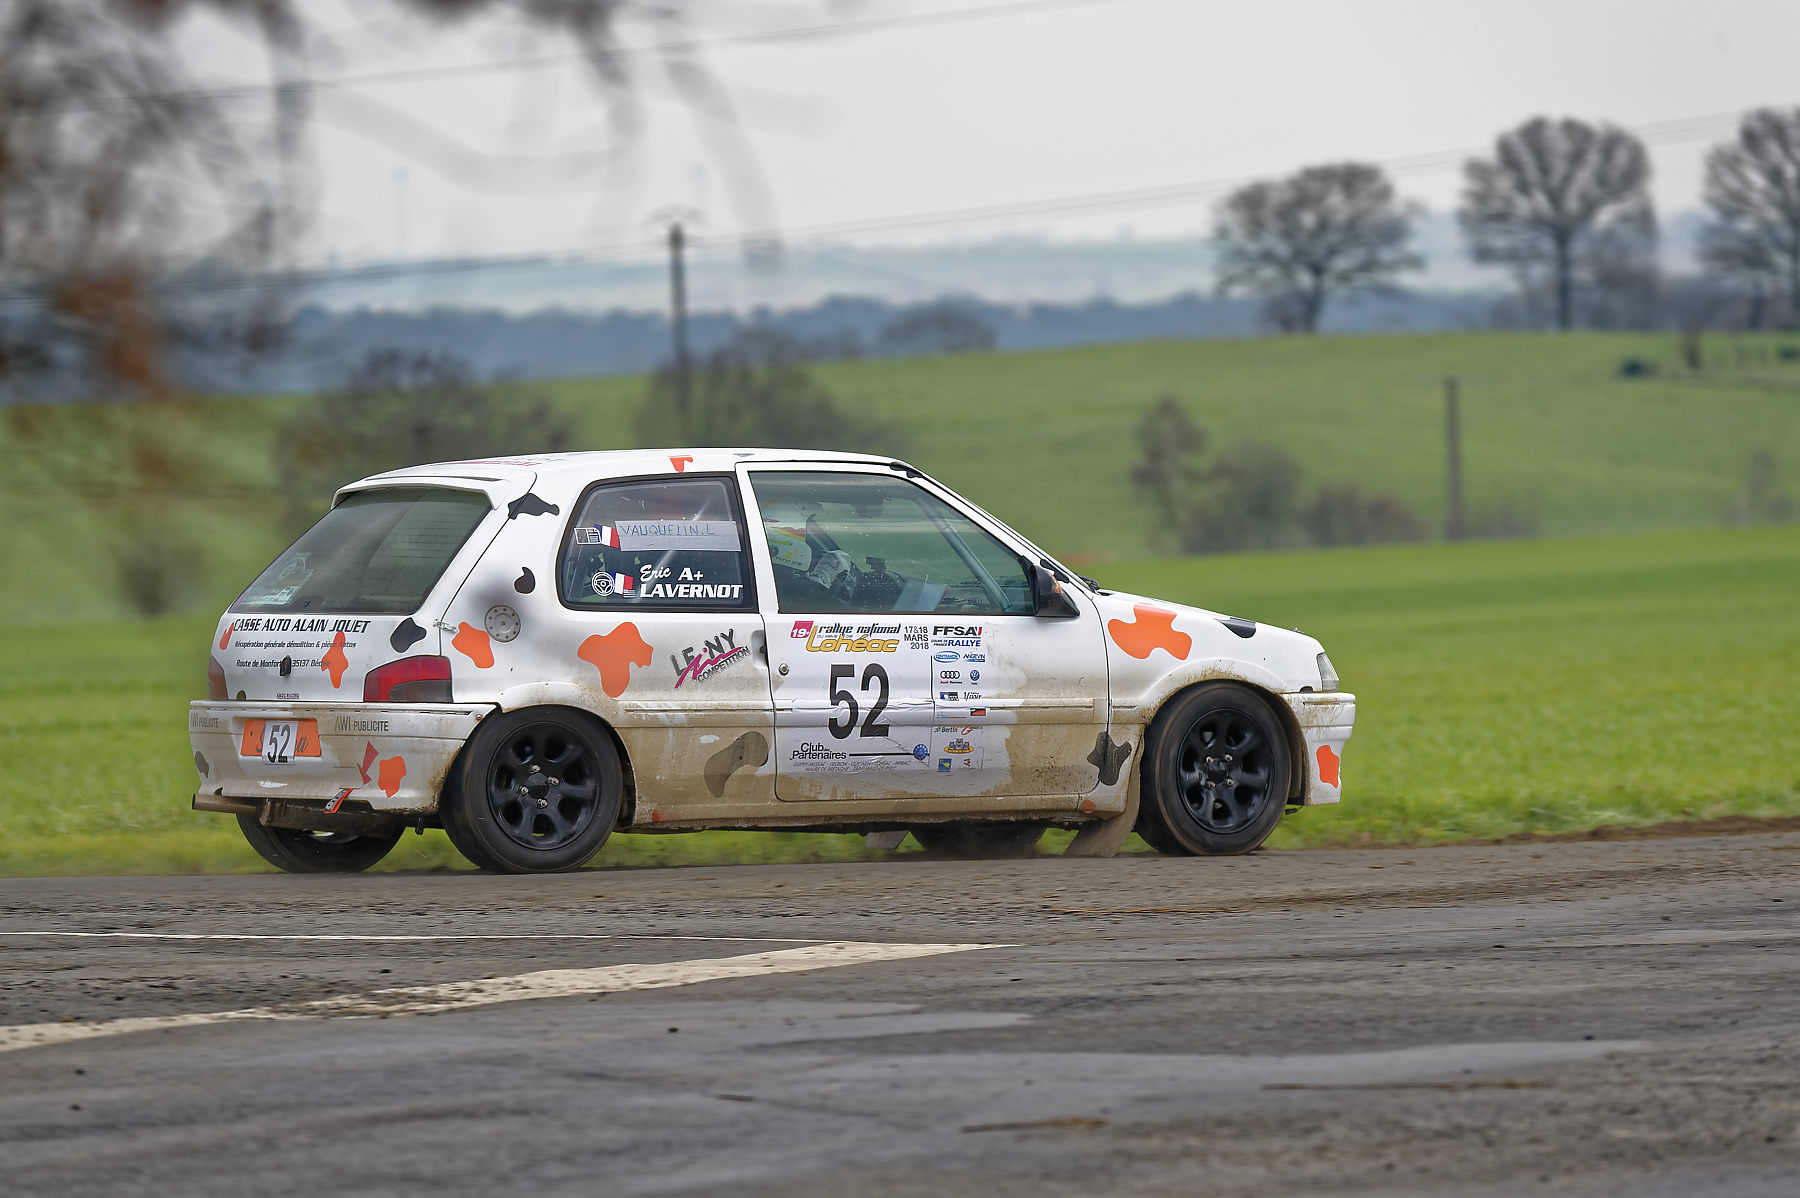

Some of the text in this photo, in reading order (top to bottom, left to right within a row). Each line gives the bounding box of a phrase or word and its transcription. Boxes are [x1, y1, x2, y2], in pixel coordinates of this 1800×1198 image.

[640, 565, 704, 582] Eric A+
[640, 584, 743, 599] LAVERNOT
[233, 618, 371, 633] CASSE AUTO ALAIN JOUET
[818, 622, 853, 637] rallye
[856, 622, 901, 637] national
[904, 625, 928, 634] 17&18
[933, 626, 977, 636] FFSA
[806, 625, 900, 653] Lohéac
[904, 634, 929, 642] MARS
[264, 641, 286, 650] générale
[910, 641, 930, 650] 2018
[236, 659, 251, 668] Route
[252, 659, 259, 668] de
[291, 659, 310, 668] 35137
[697, 646, 751, 683] COMPETITION
[829, 663, 890, 740] 52
[335, 716, 389, 732] AWI PUBLICITE
[941, 726, 958, 734] Bertin
[266, 724, 291, 763] 52
[800, 742, 824, 753] Club
[792, 750, 847, 760] Partenaires
